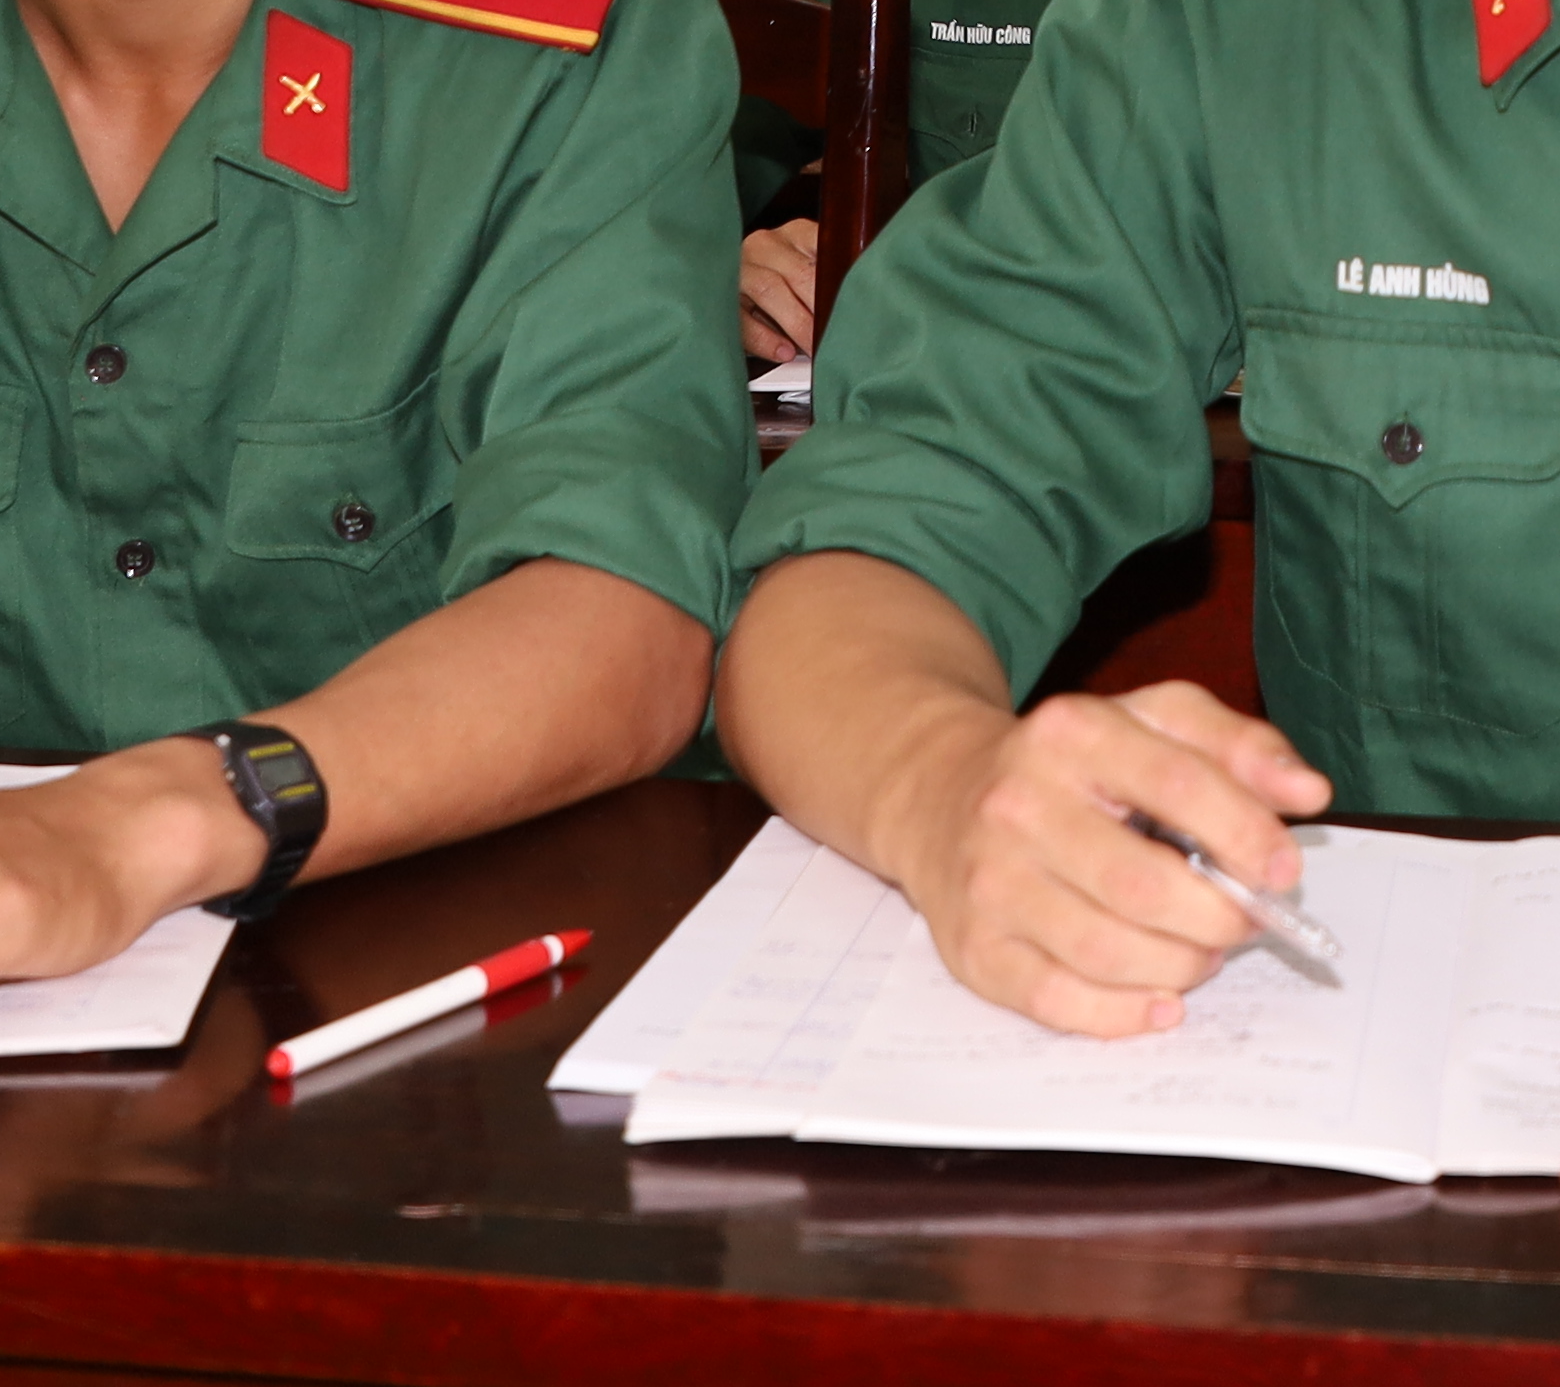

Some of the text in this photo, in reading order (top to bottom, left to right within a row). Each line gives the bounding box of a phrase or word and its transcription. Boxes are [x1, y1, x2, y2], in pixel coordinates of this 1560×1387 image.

[931, 18, 1031, 45] TRẦN HỮU CÔNG
[1337, 256, 1365, 294] LÊ
[1369, 263, 1422, 298] ANH
